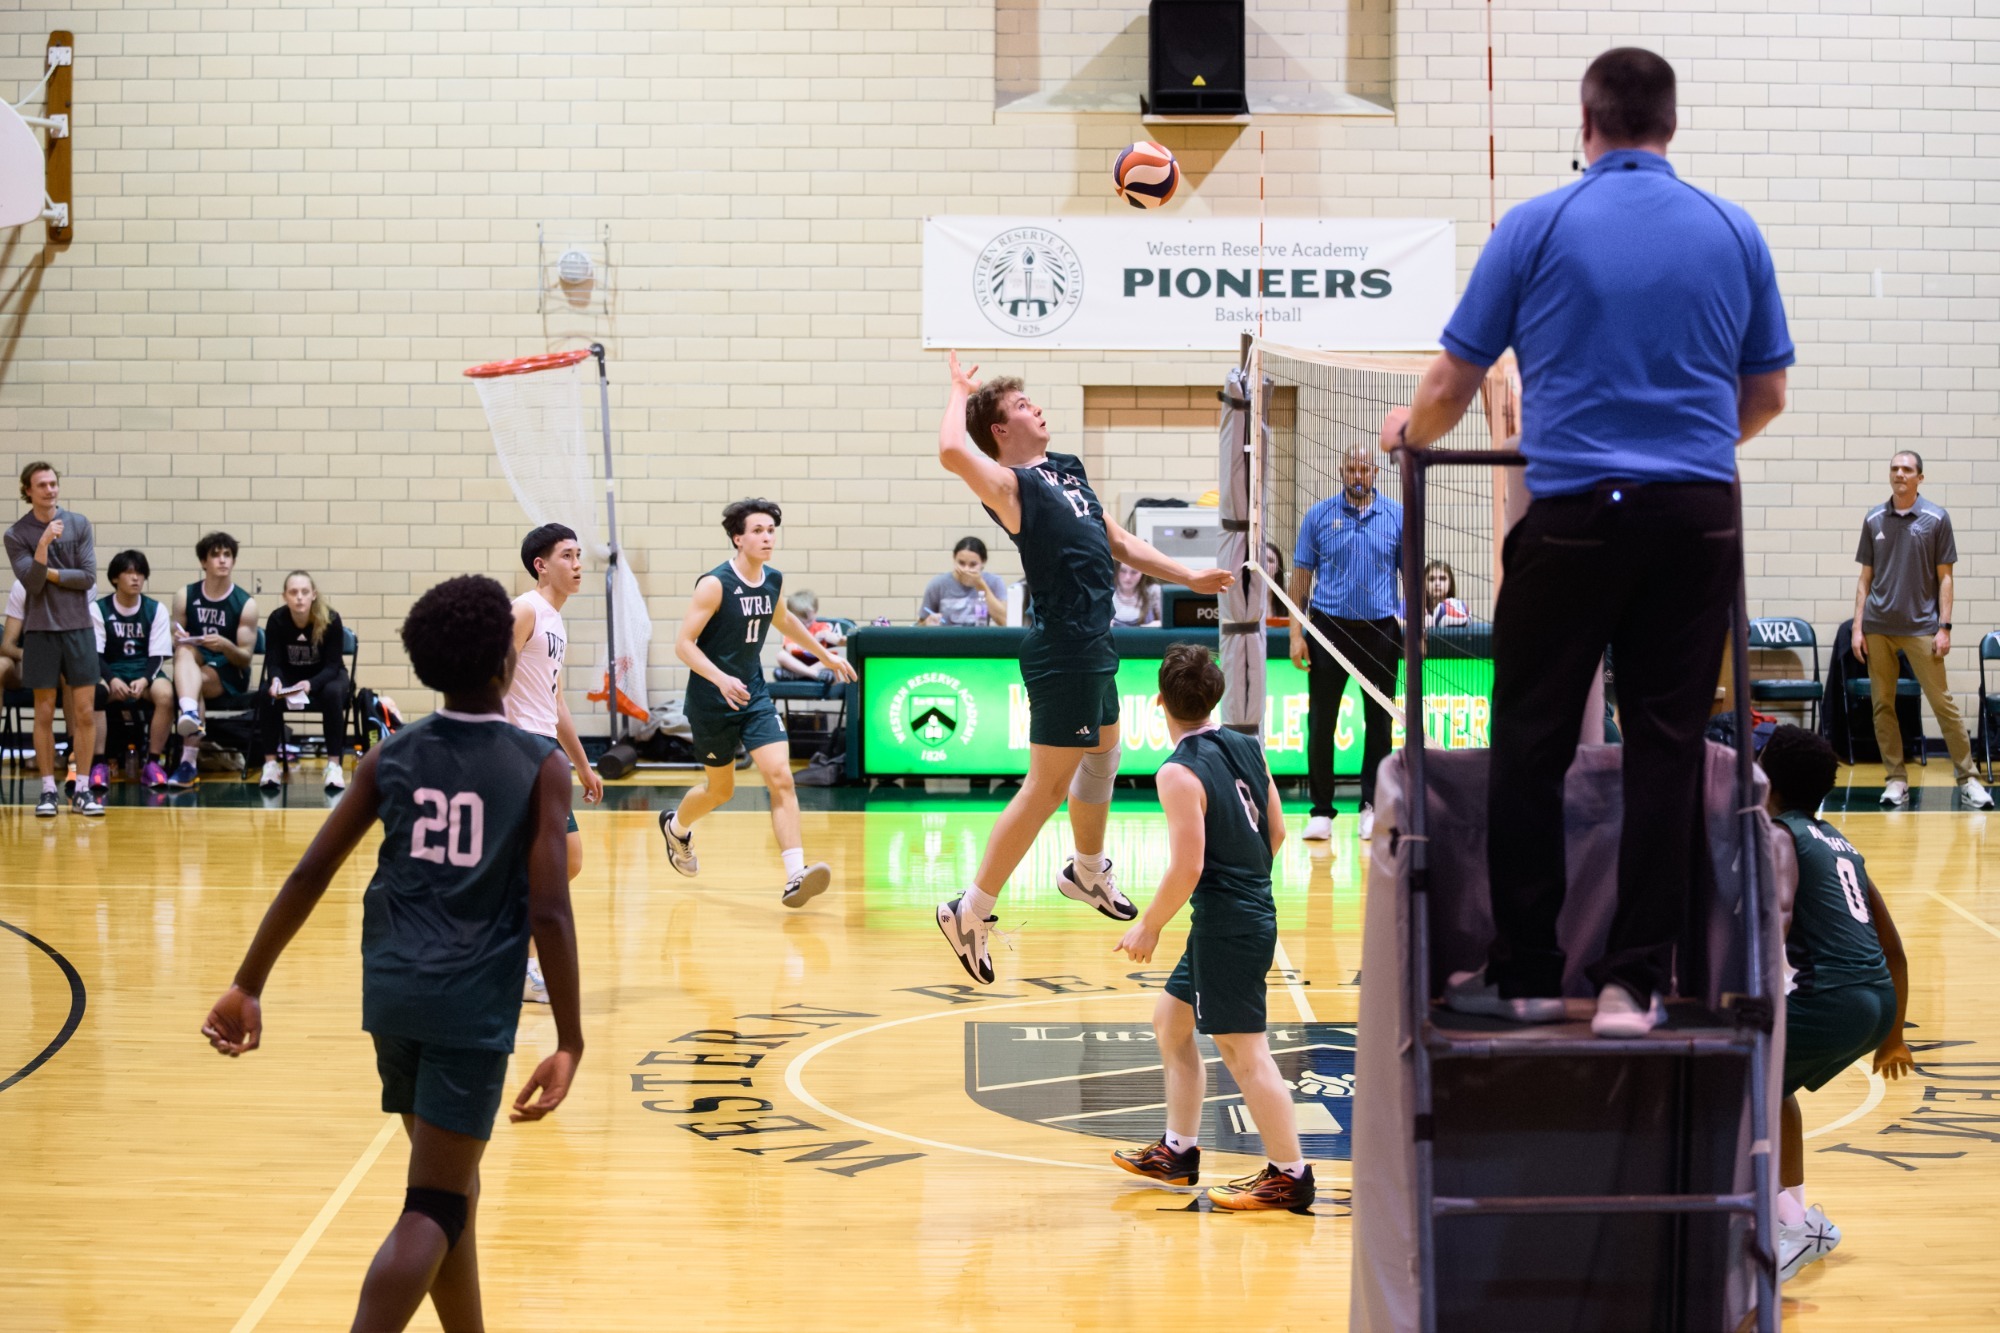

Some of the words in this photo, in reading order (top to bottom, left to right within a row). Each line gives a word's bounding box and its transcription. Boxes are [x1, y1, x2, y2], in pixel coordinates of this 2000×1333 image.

[1147, 241, 1216, 257] Western
[1222, 242, 1287, 257] Reserve
[1291, 242, 1369, 260] Academy
[977, 245, 998, 307] WESTERN
[998, 230, 1056, 248] RESERVE
[1057, 245, 1080, 306] ACADEMY
[1123, 267, 1393, 299] PIONEERS
[1215, 307, 1302, 322] Basketball
[1017, 323, 1041, 334] 1826
[196, 607, 226, 627] WRA
[739, 594, 773, 617] WRA
[113, 621, 146, 638] WRA
[745, 618, 761, 644] 11
[1755, 621, 1802, 643] WRA
[545, 631, 567, 665] WR
[907, 671, 961, 690] RESERVE
[410, 786, 484, 868] 20
[1836, 856, 1870, 924] 0
[630, 1002, 928, 1178] WESTERN
